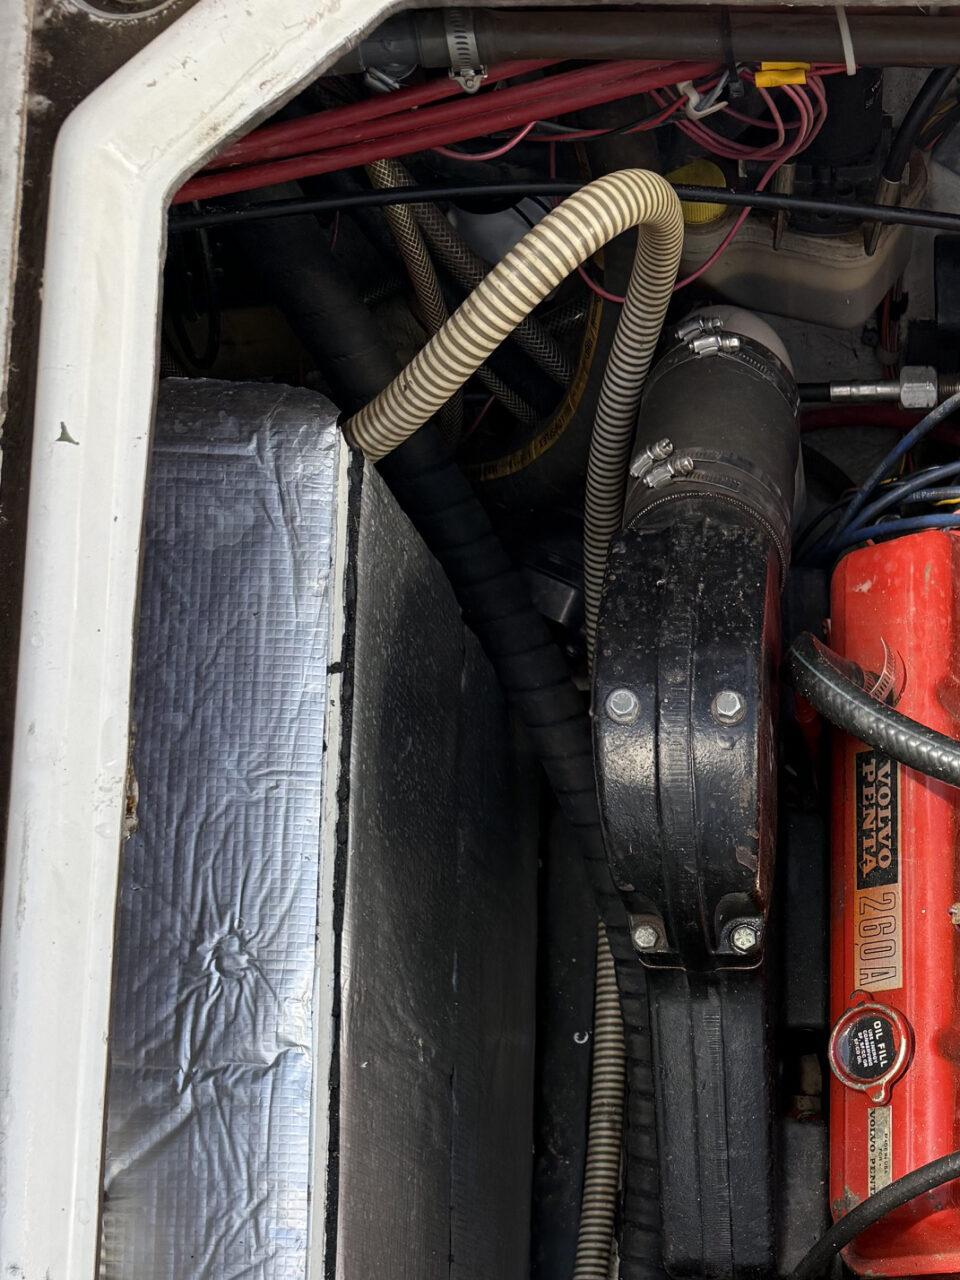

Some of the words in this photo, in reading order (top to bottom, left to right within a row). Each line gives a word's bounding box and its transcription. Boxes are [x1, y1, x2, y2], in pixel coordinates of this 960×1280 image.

[859, 757, 878, 879] PENTA
[875, 760, 892, 869] VOLVO
[856, 890, 899, 987] 260A
[862, 1029, 872, 1066] CONSERVING
[873, 1020, 883, 1039] OIL
[862, 1058, 867, 1067] OR
[877, 1042, 888, 1067] FILL
